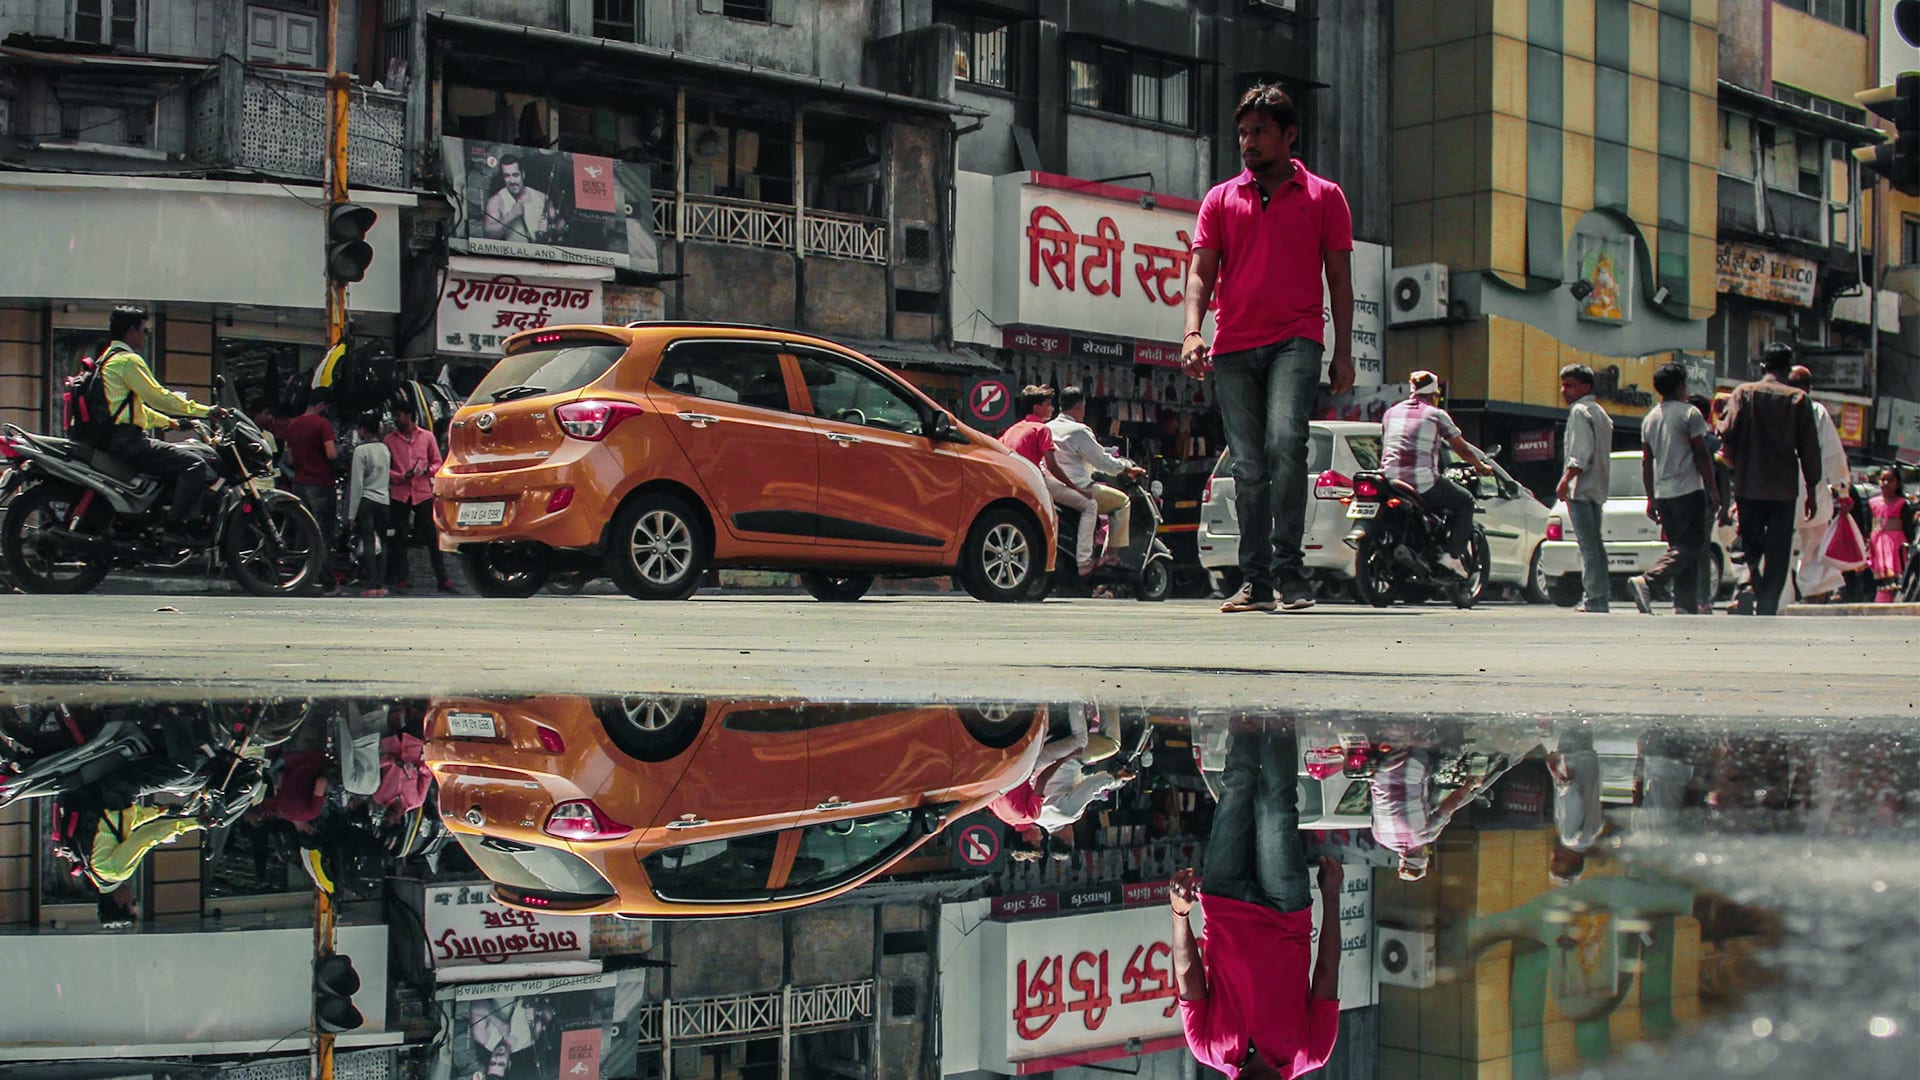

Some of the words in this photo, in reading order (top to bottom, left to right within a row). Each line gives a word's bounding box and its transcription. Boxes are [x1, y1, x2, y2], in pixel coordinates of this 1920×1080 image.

[534, 249, 556, 259] AND
[561, 252, 616, 266] BROTHERS
[1026, 205, 1125, 298] सिटी
[446, 274, 594, 310] रमणिकलाल
[1015, 332, 1037, 346] कोट
[1082, 340, 1124, 356] शेरवानी
